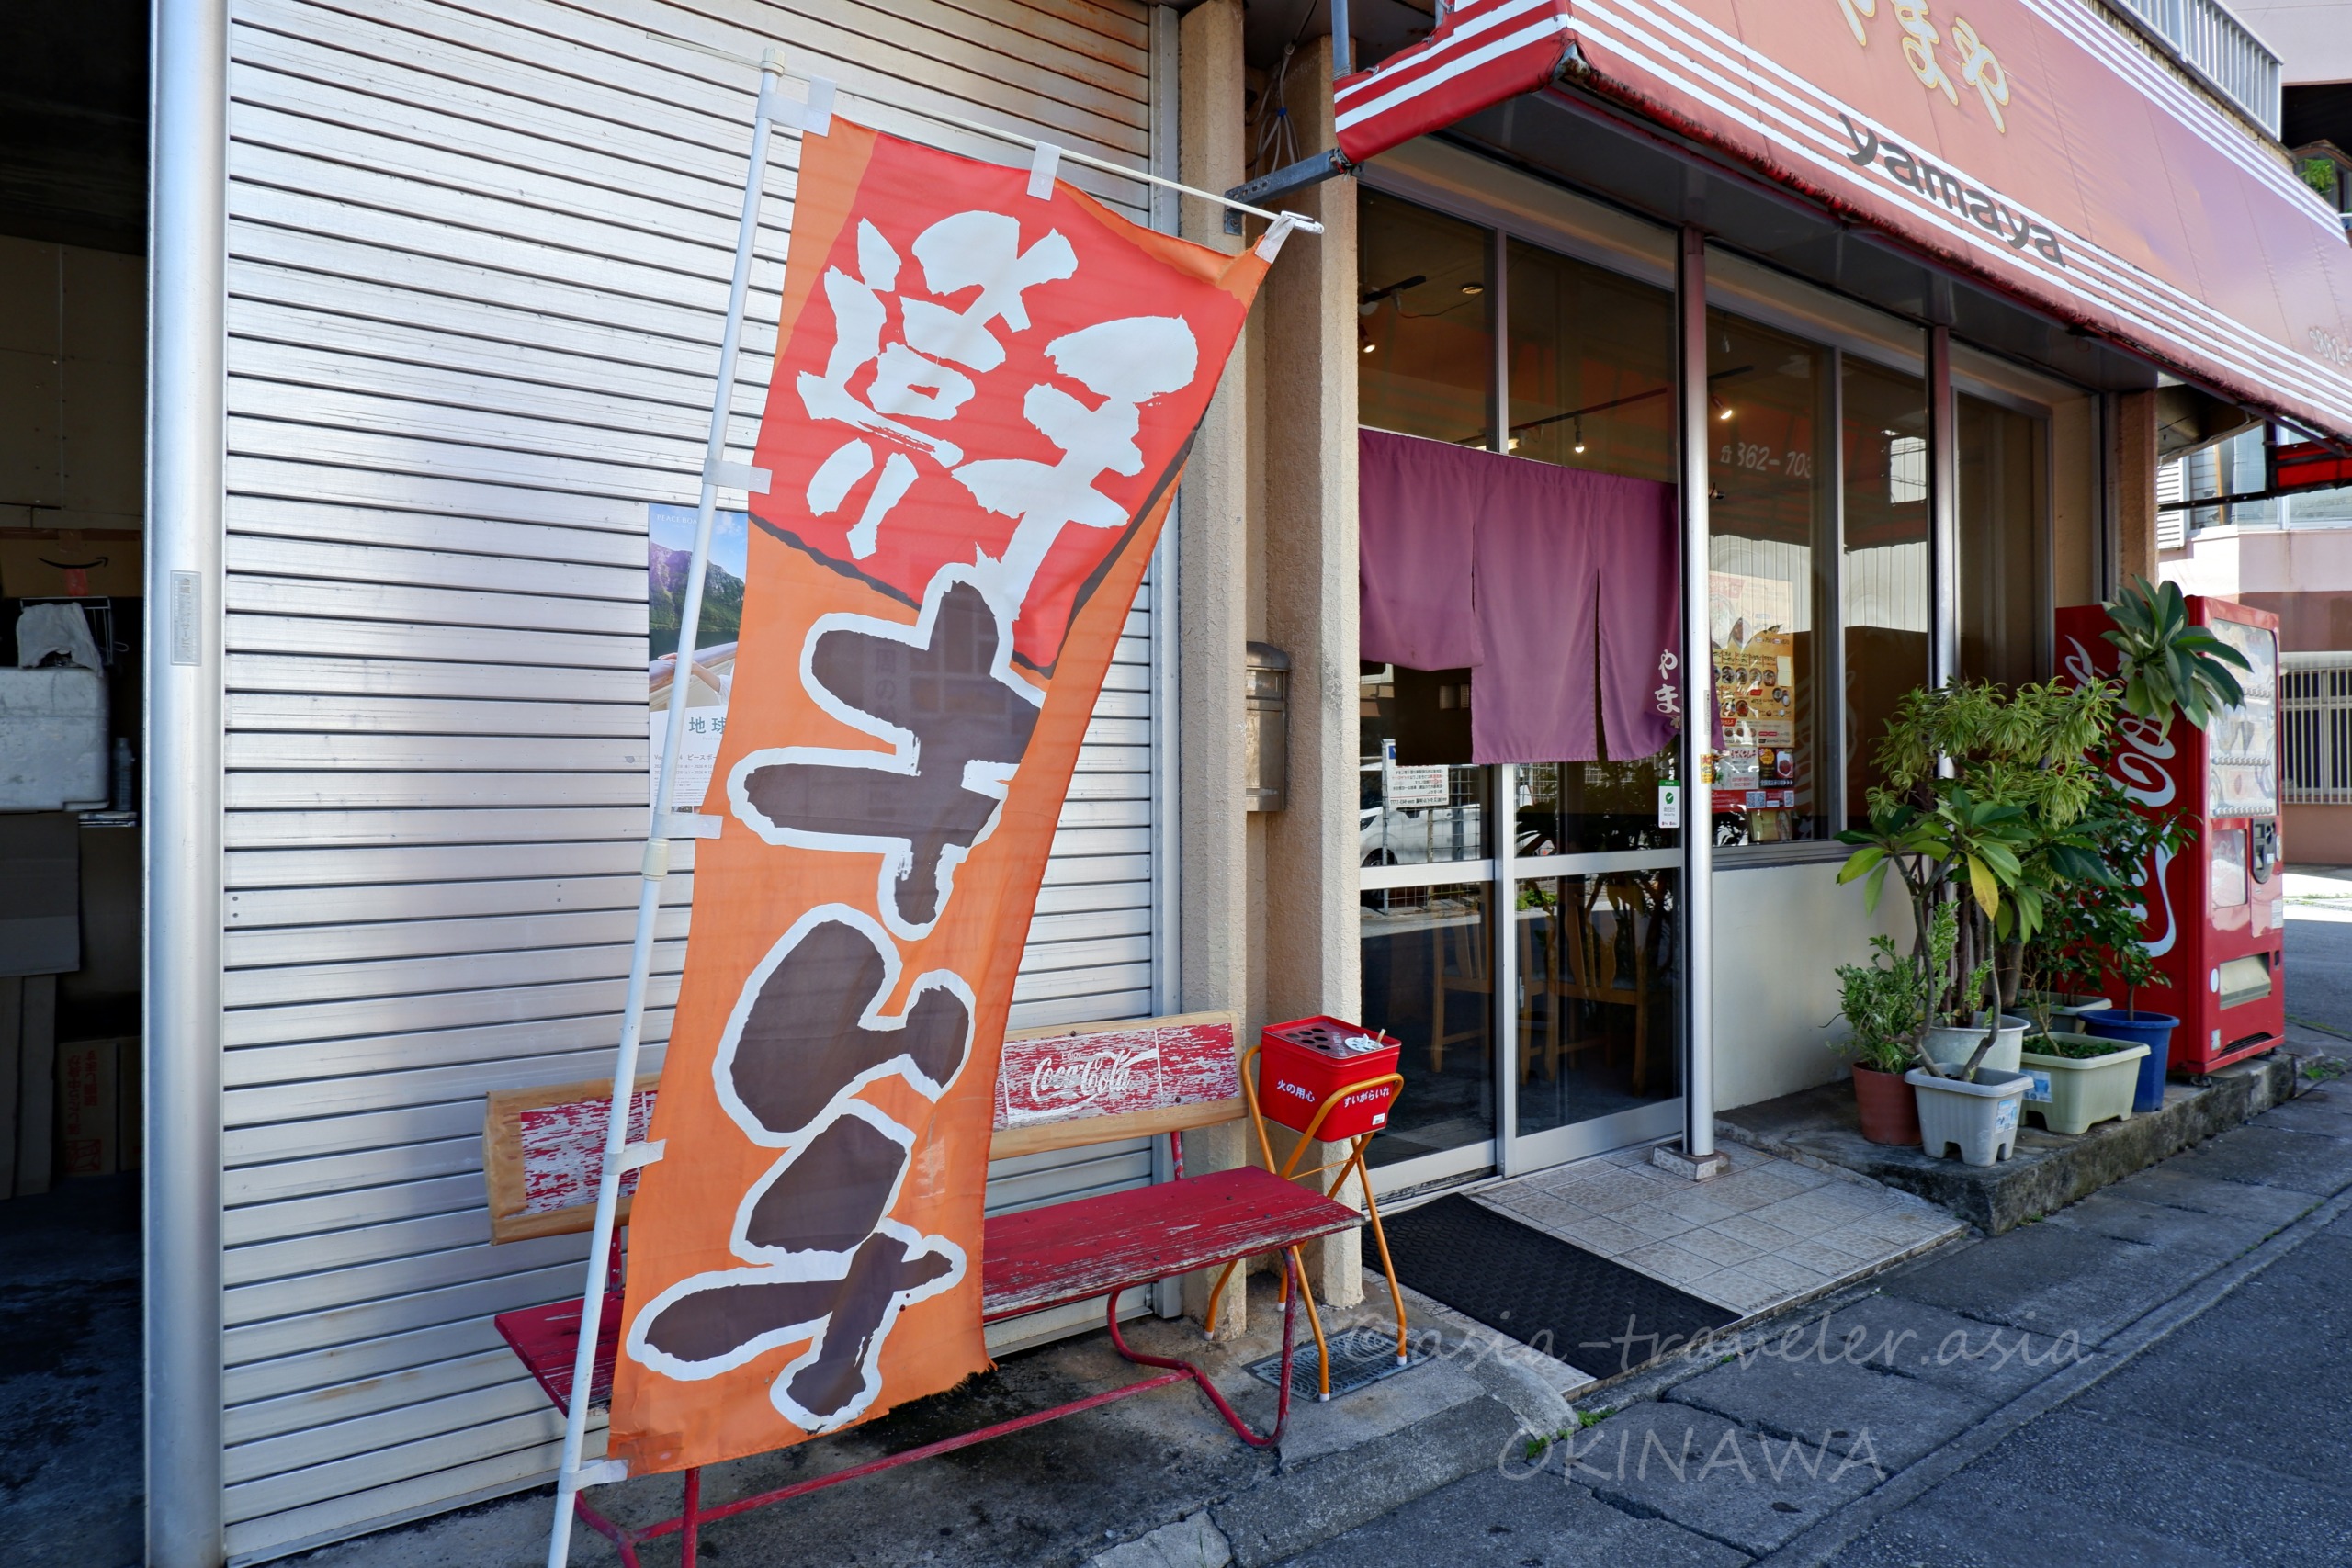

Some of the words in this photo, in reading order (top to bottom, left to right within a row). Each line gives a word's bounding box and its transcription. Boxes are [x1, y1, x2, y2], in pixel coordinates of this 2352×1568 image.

[1838, 112, 2066, 269] yamaya
[682, 516, 698, 525] BOA
[1030, 1049, 1133, 1102] Coca-Cola
[1276, 1079, 1316, 1103] 火の用心
[1343, 1087, 1390, 1108] すいがらいれ
